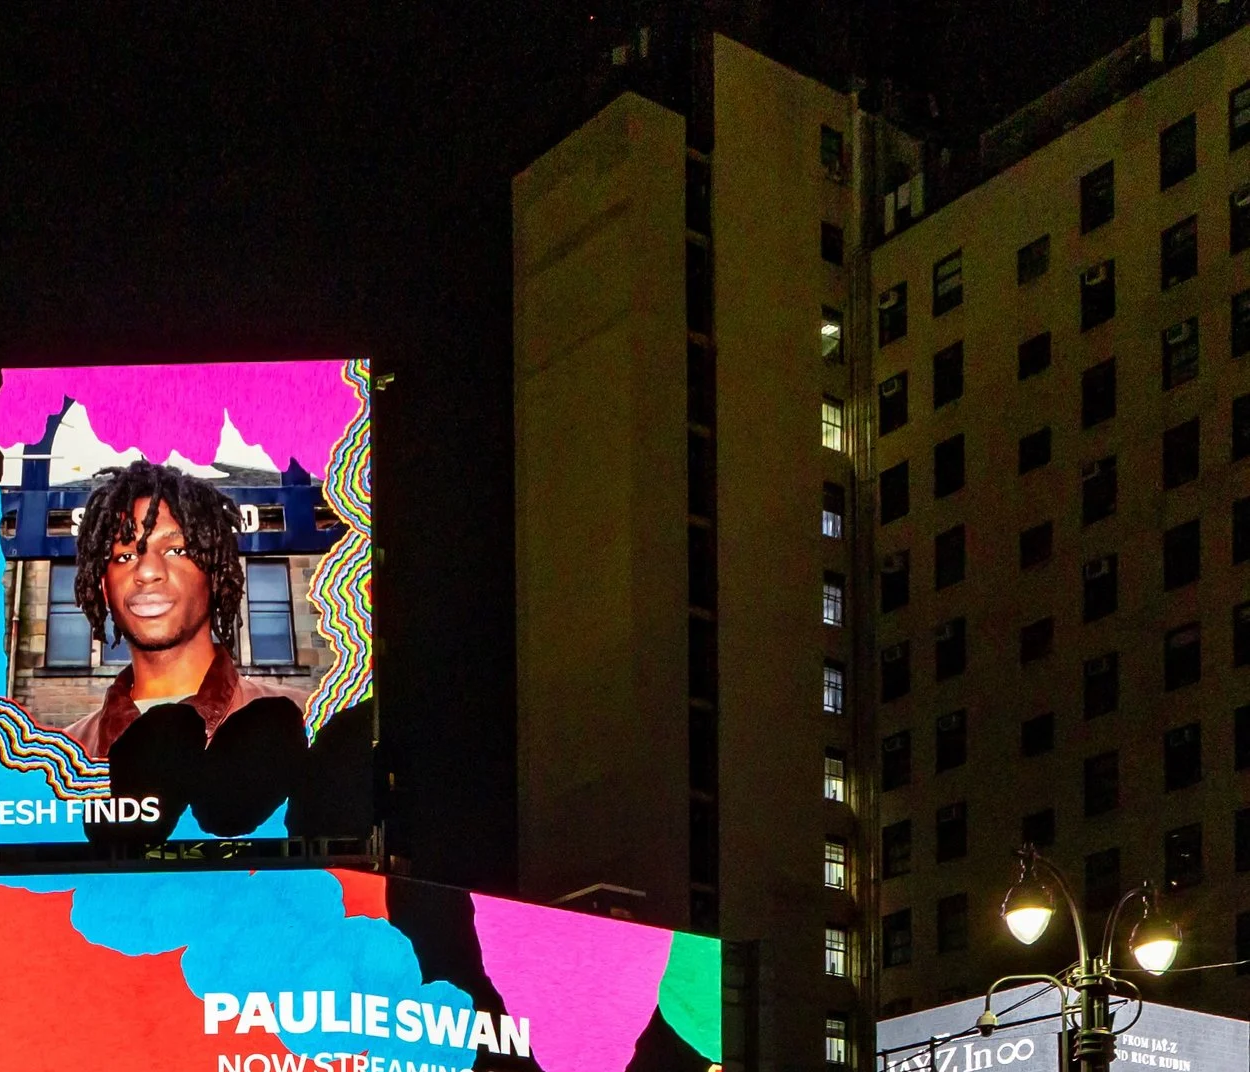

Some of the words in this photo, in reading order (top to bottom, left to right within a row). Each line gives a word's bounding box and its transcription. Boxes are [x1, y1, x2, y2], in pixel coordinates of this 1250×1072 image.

[66, 797, 160, 824] FINDS
[204, 991, 388, 1037] PAULIE
[396, 999, 530, 1058] SWAN
[1122, 1034, 1148, 1049] FROM
[1113, 1049, 1129, 1061] ND
[1131, 1051, 1157, 1066] RICK
[1159, 1056, 1190, 1071] RUBIN
